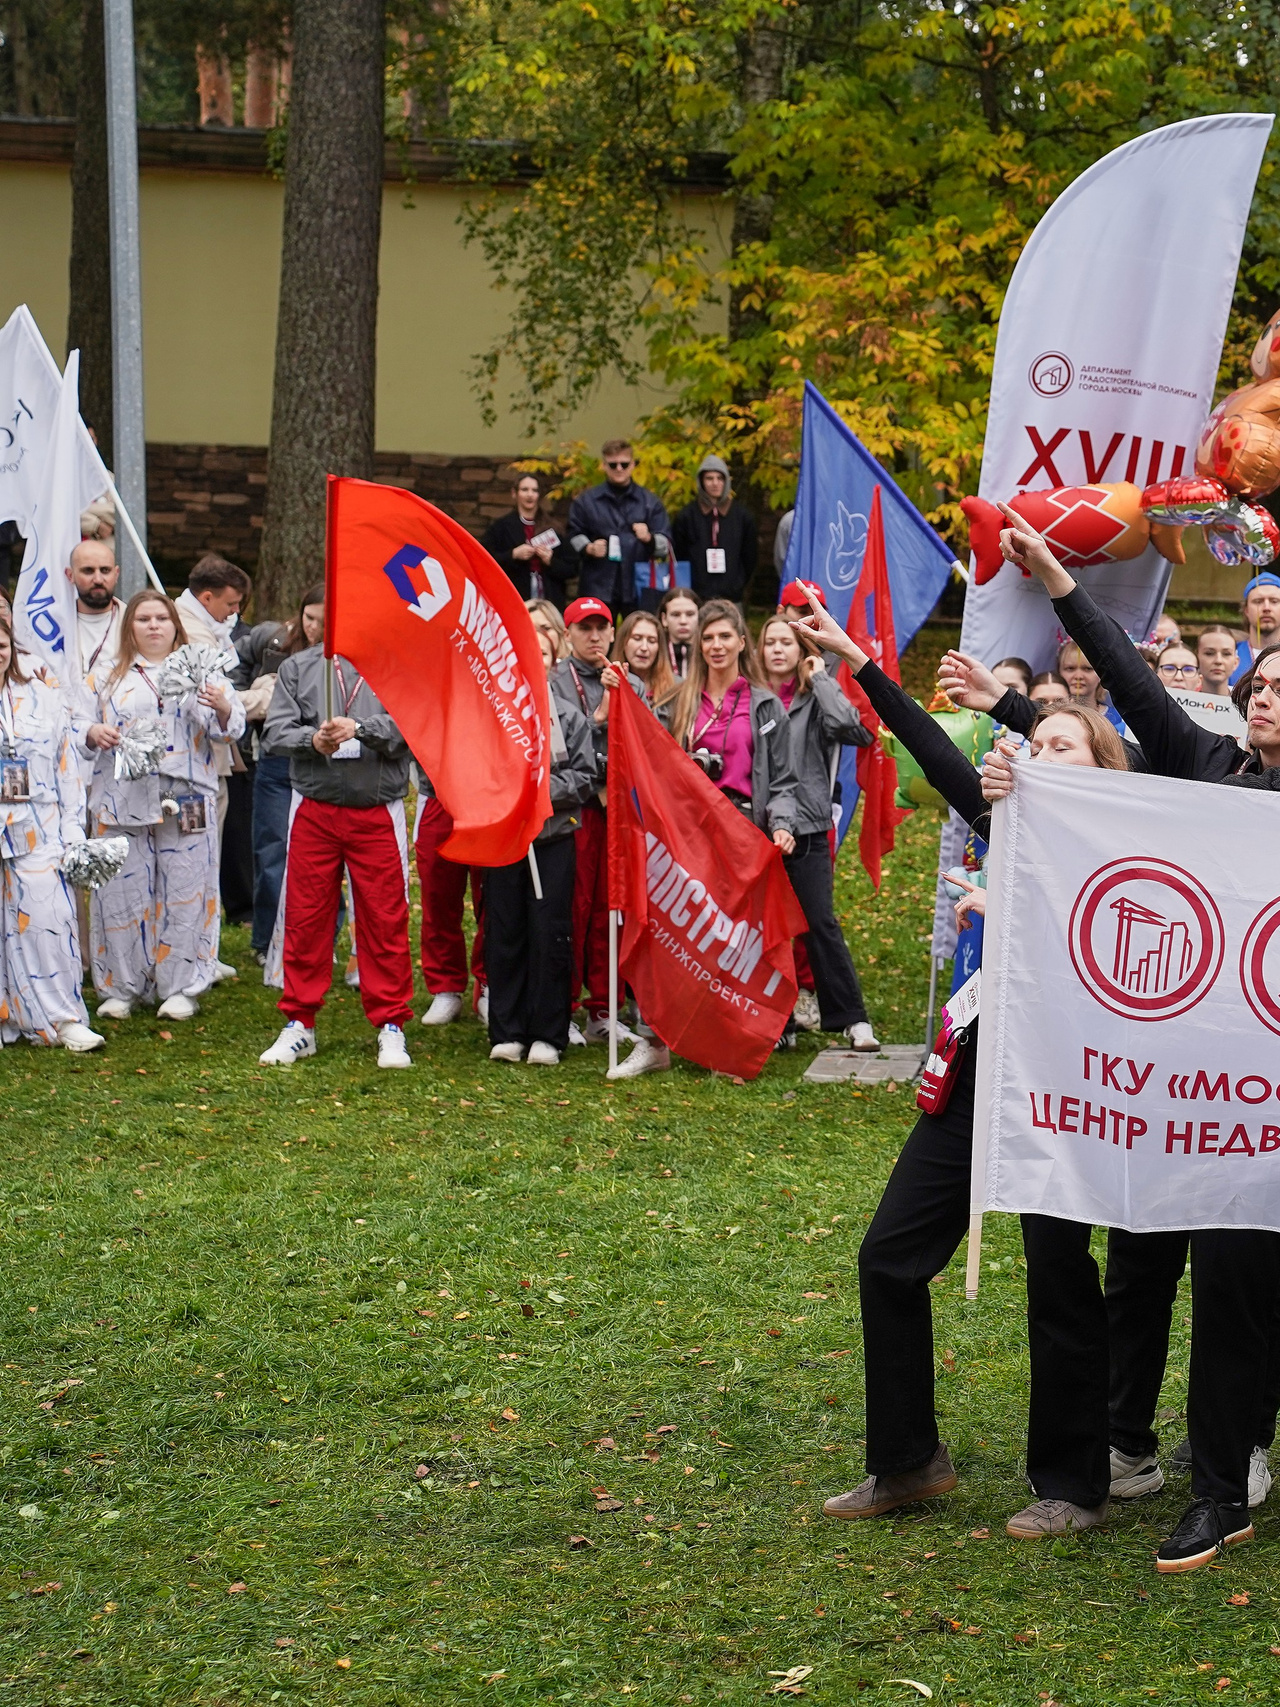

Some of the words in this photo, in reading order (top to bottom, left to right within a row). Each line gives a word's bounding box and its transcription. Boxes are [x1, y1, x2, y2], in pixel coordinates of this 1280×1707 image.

[1078, 382, 1110, 394] ГОРОДА
[1110, 386, 1142, 397] МОСКВЫ
[1079, 374, 1158, 391] ГРАДОСТРОИТЕЛЬНОЙ
[1158, 384, 1198, 400] ПОЛИТИКИ
[1080, 364, 1132, 376] ДЕПАРТАМЕНТ
[1016, 425, 1187, 489] XVIII
[466, 653, 536, 763] «МОСИНЖПРО
[648, 917, 760, 1017] СИНЖПРОЕКТ»
[1083, 1046, 1155, 1096] ГКУ
[1029, 1092, 1148, 1150] ЦЕНТР
